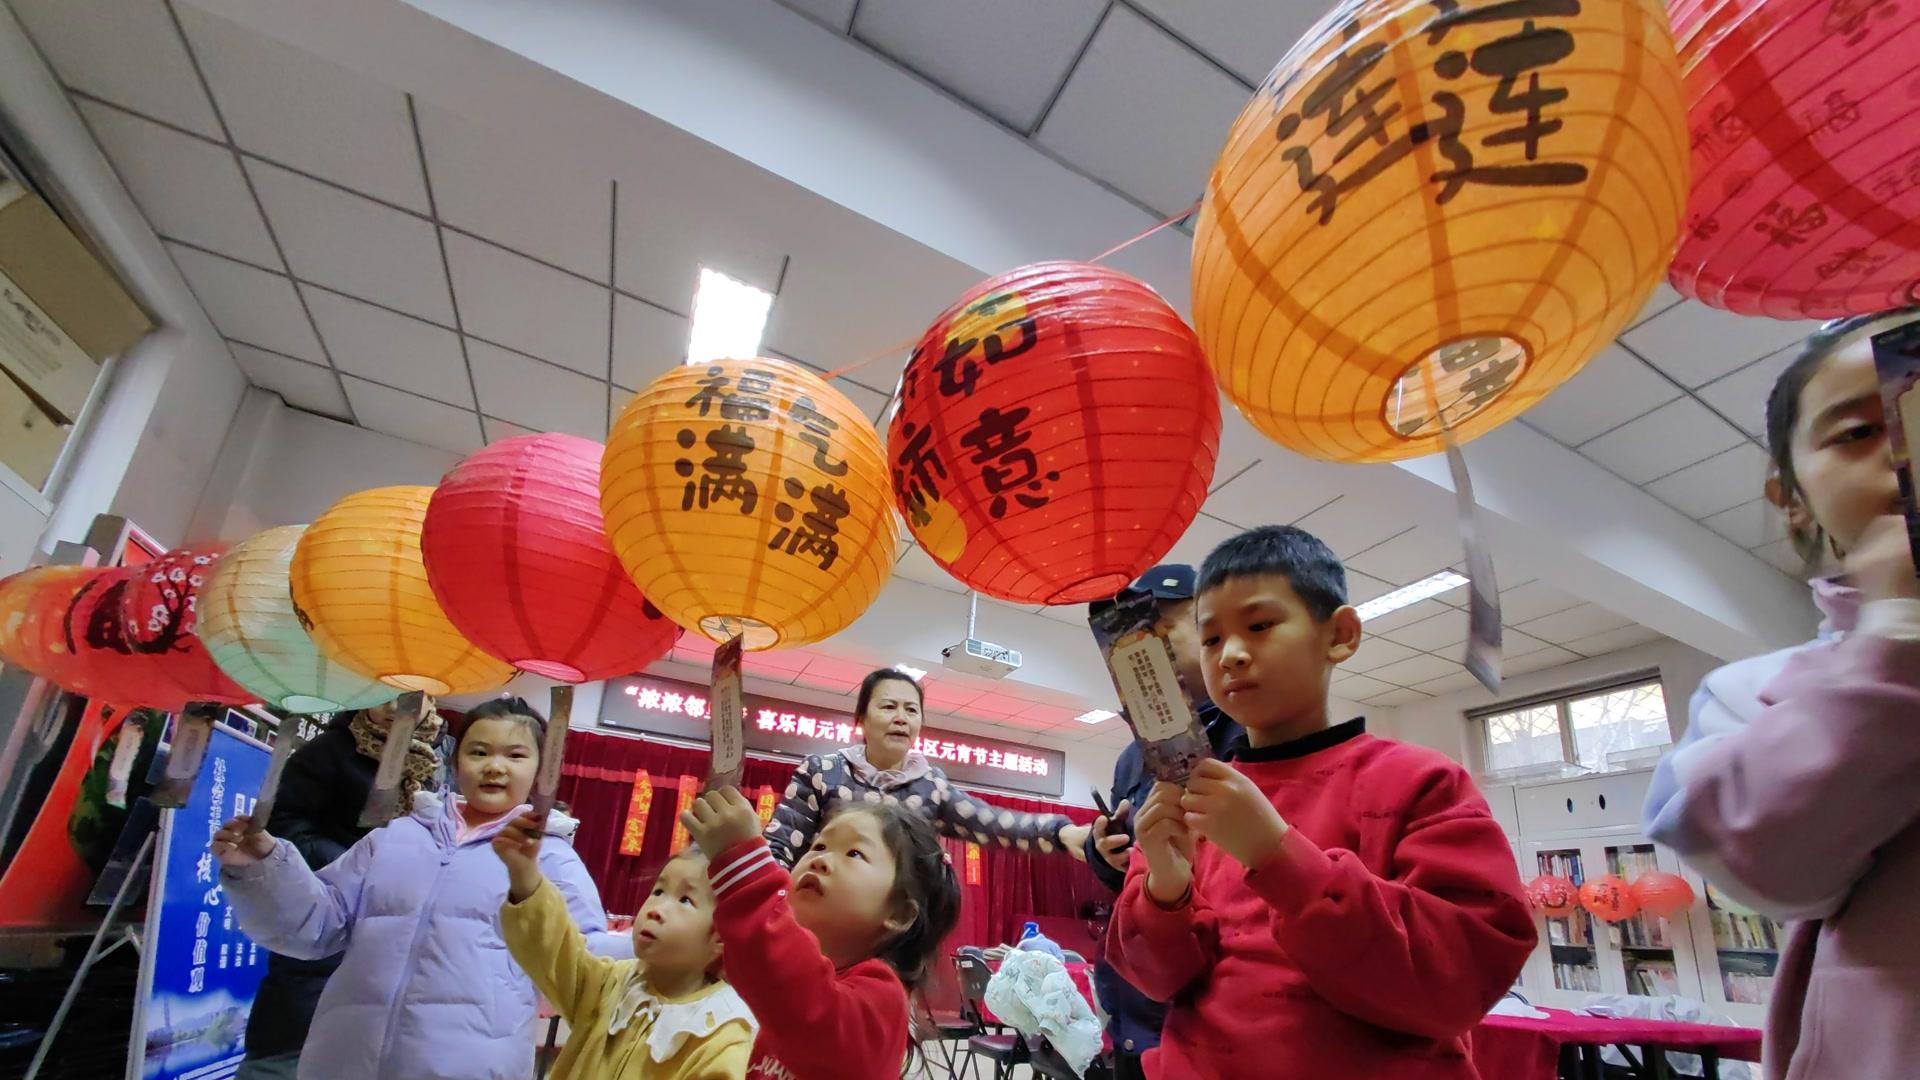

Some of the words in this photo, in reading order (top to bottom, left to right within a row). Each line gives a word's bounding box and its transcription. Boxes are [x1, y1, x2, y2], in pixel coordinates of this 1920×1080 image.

[684, 365, 849, 477] 福气
[931, 317, 1061, 521] 如意
[674, 424, 851, 572] 满满
